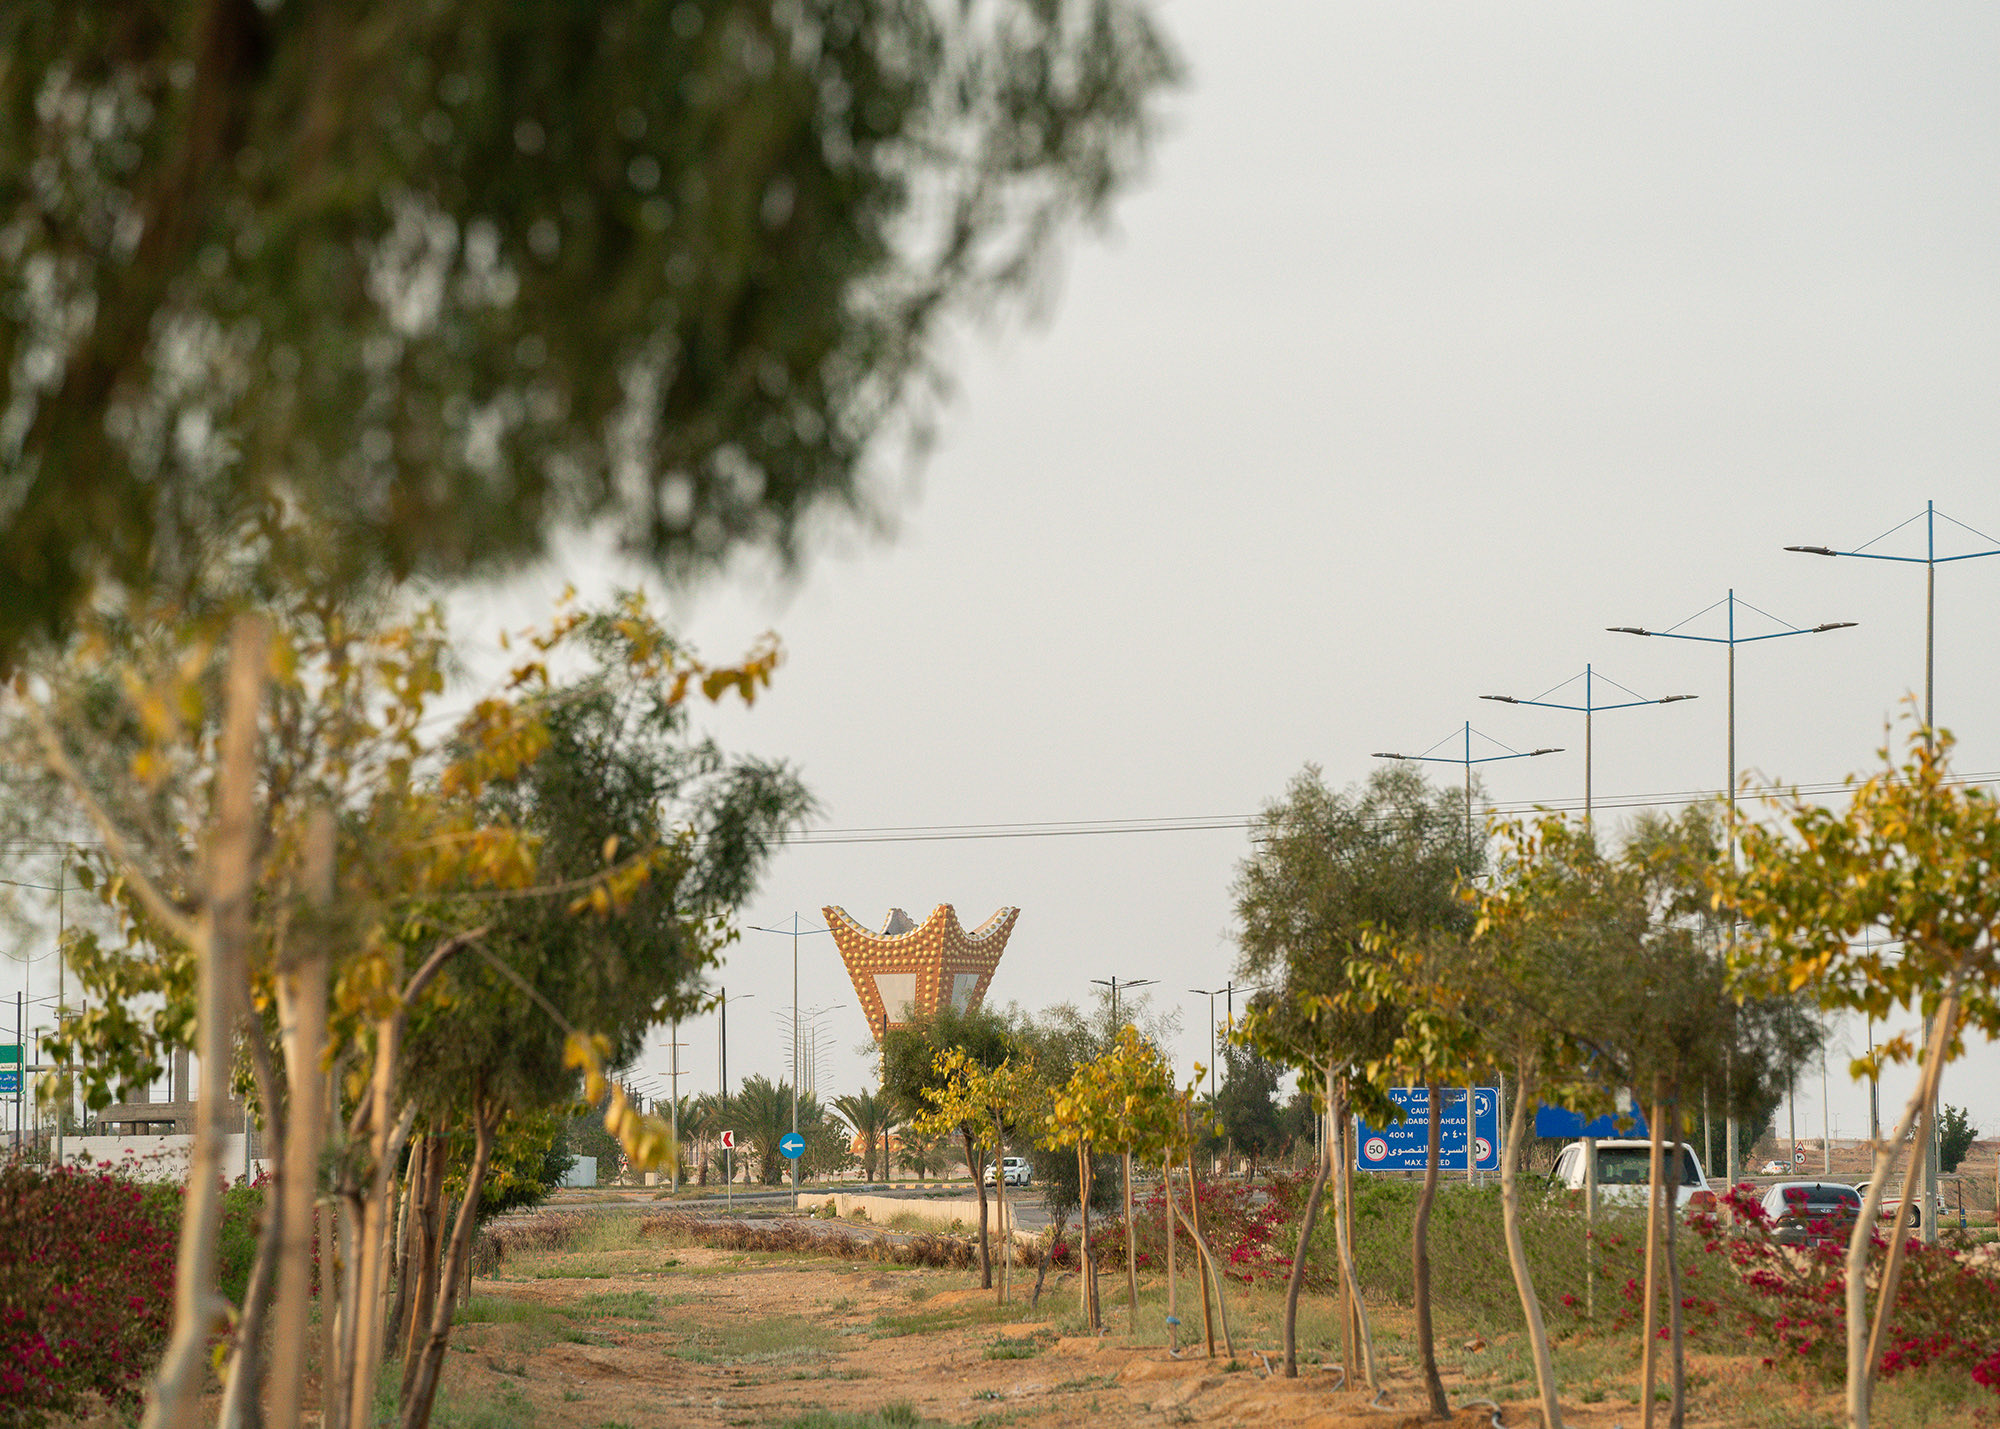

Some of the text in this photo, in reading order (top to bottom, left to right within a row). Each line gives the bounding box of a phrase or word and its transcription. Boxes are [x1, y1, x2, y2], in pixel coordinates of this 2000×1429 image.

[1410, 1107, 1442, 1115] CAUT
[1388, 1131, 1414, 1139] 400 M
[1368, 1144, 1384, 1154] 50
[1438, 1145, 1467, 1156] السرع
